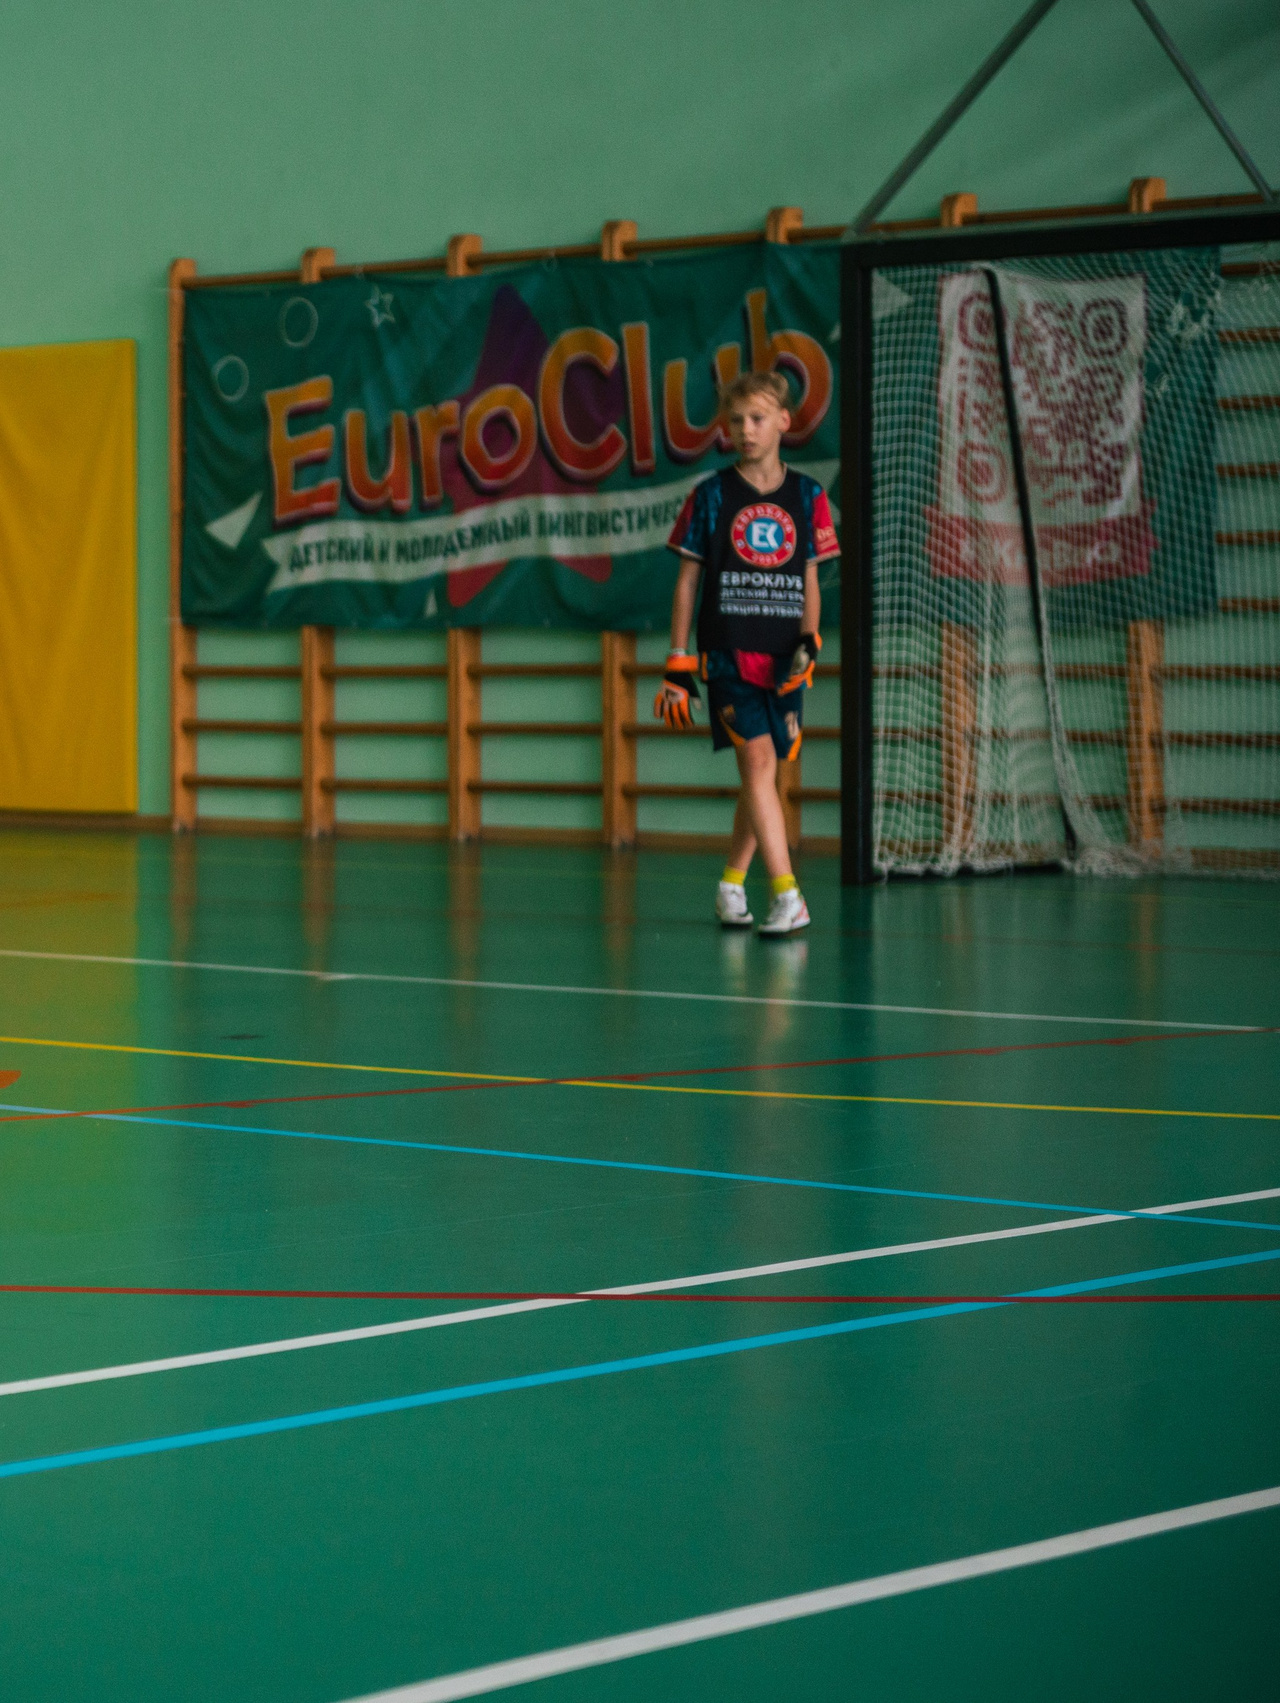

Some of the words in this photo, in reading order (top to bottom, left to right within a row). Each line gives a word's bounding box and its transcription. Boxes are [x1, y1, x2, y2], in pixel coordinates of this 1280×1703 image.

[265, 288, 833, 527] EuroClub
[289, 533, 374, 573] ДЕТСКИЙ
[379, 539, 390, 564] И
[538, 496, 684, 538] ЛИНГВИСТИЧЕС
[721, 571, 803, 591] ЕВРОКЛУБ
